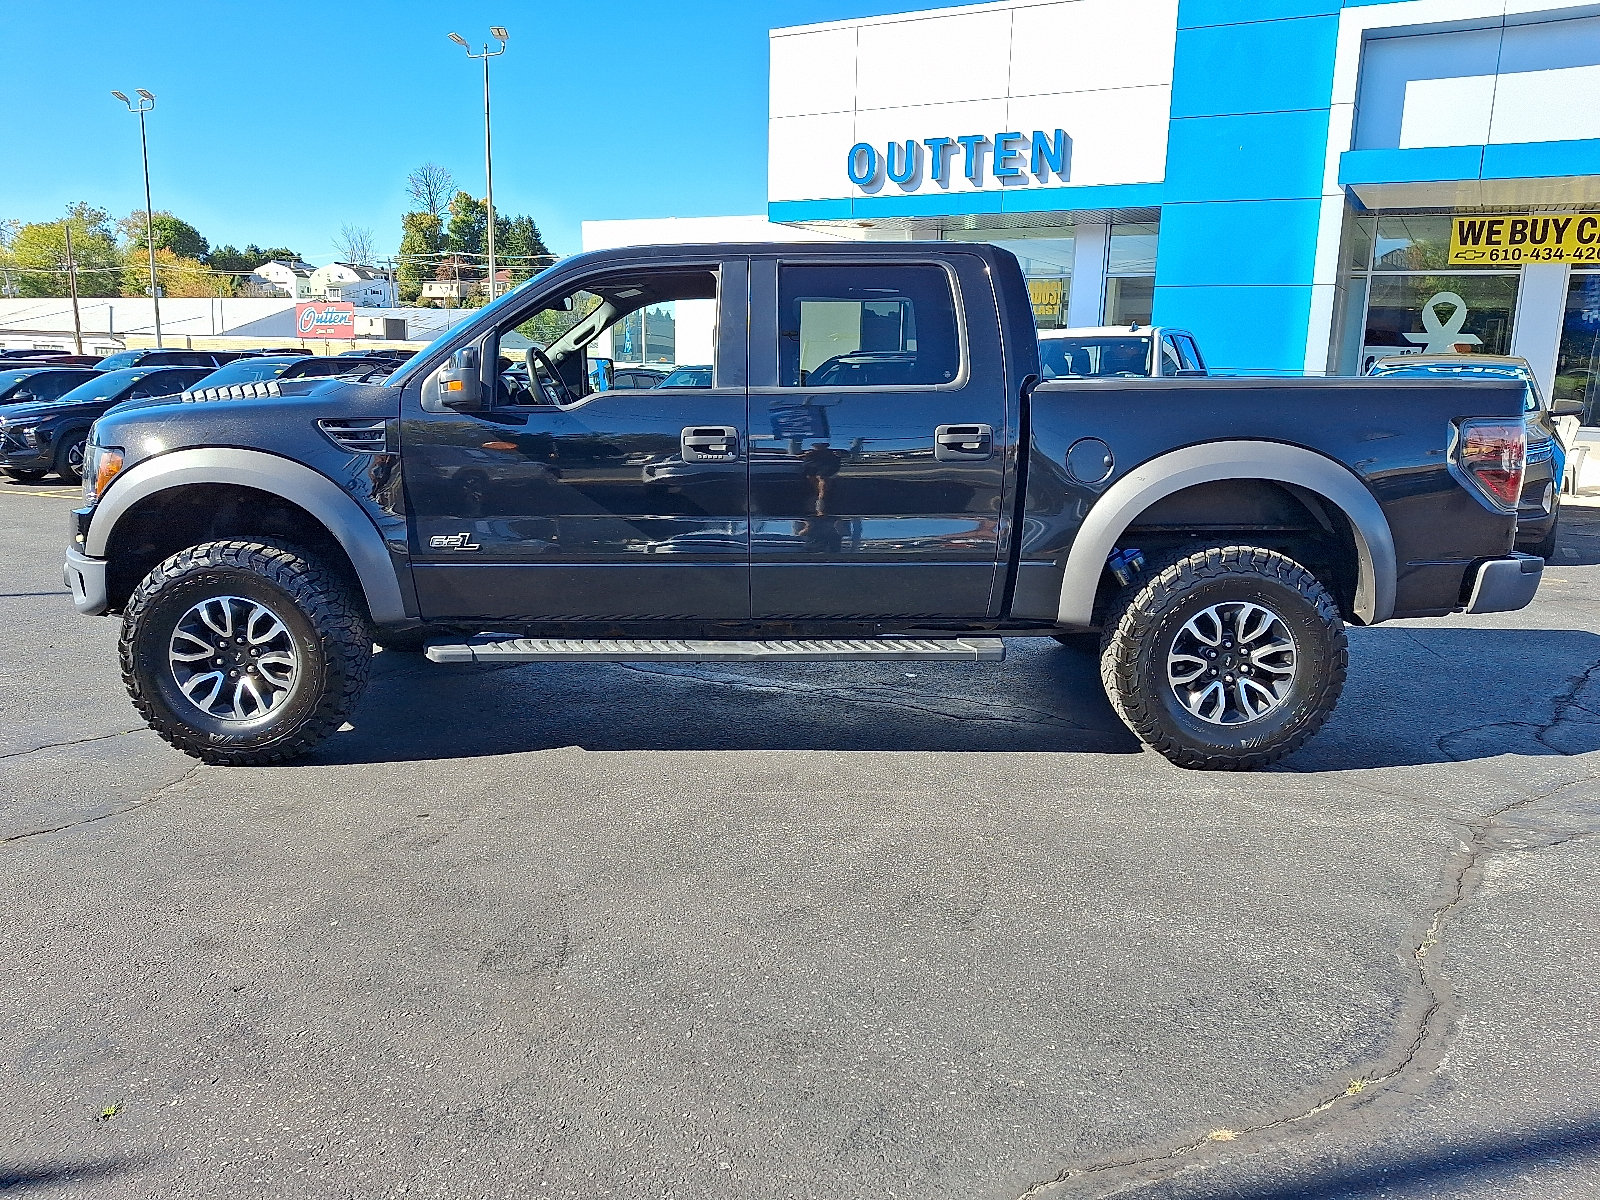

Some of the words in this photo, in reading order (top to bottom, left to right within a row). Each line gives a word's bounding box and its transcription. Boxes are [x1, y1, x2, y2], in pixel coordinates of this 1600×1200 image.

[847, 128, 1067, 188] OUTTEN
[1457, 219, 1504, 246] WE
[1508, 216, 1573, 246] BUY
[1576, 216, 1600, 245] C
[298, 307, 353, 333] Outten
